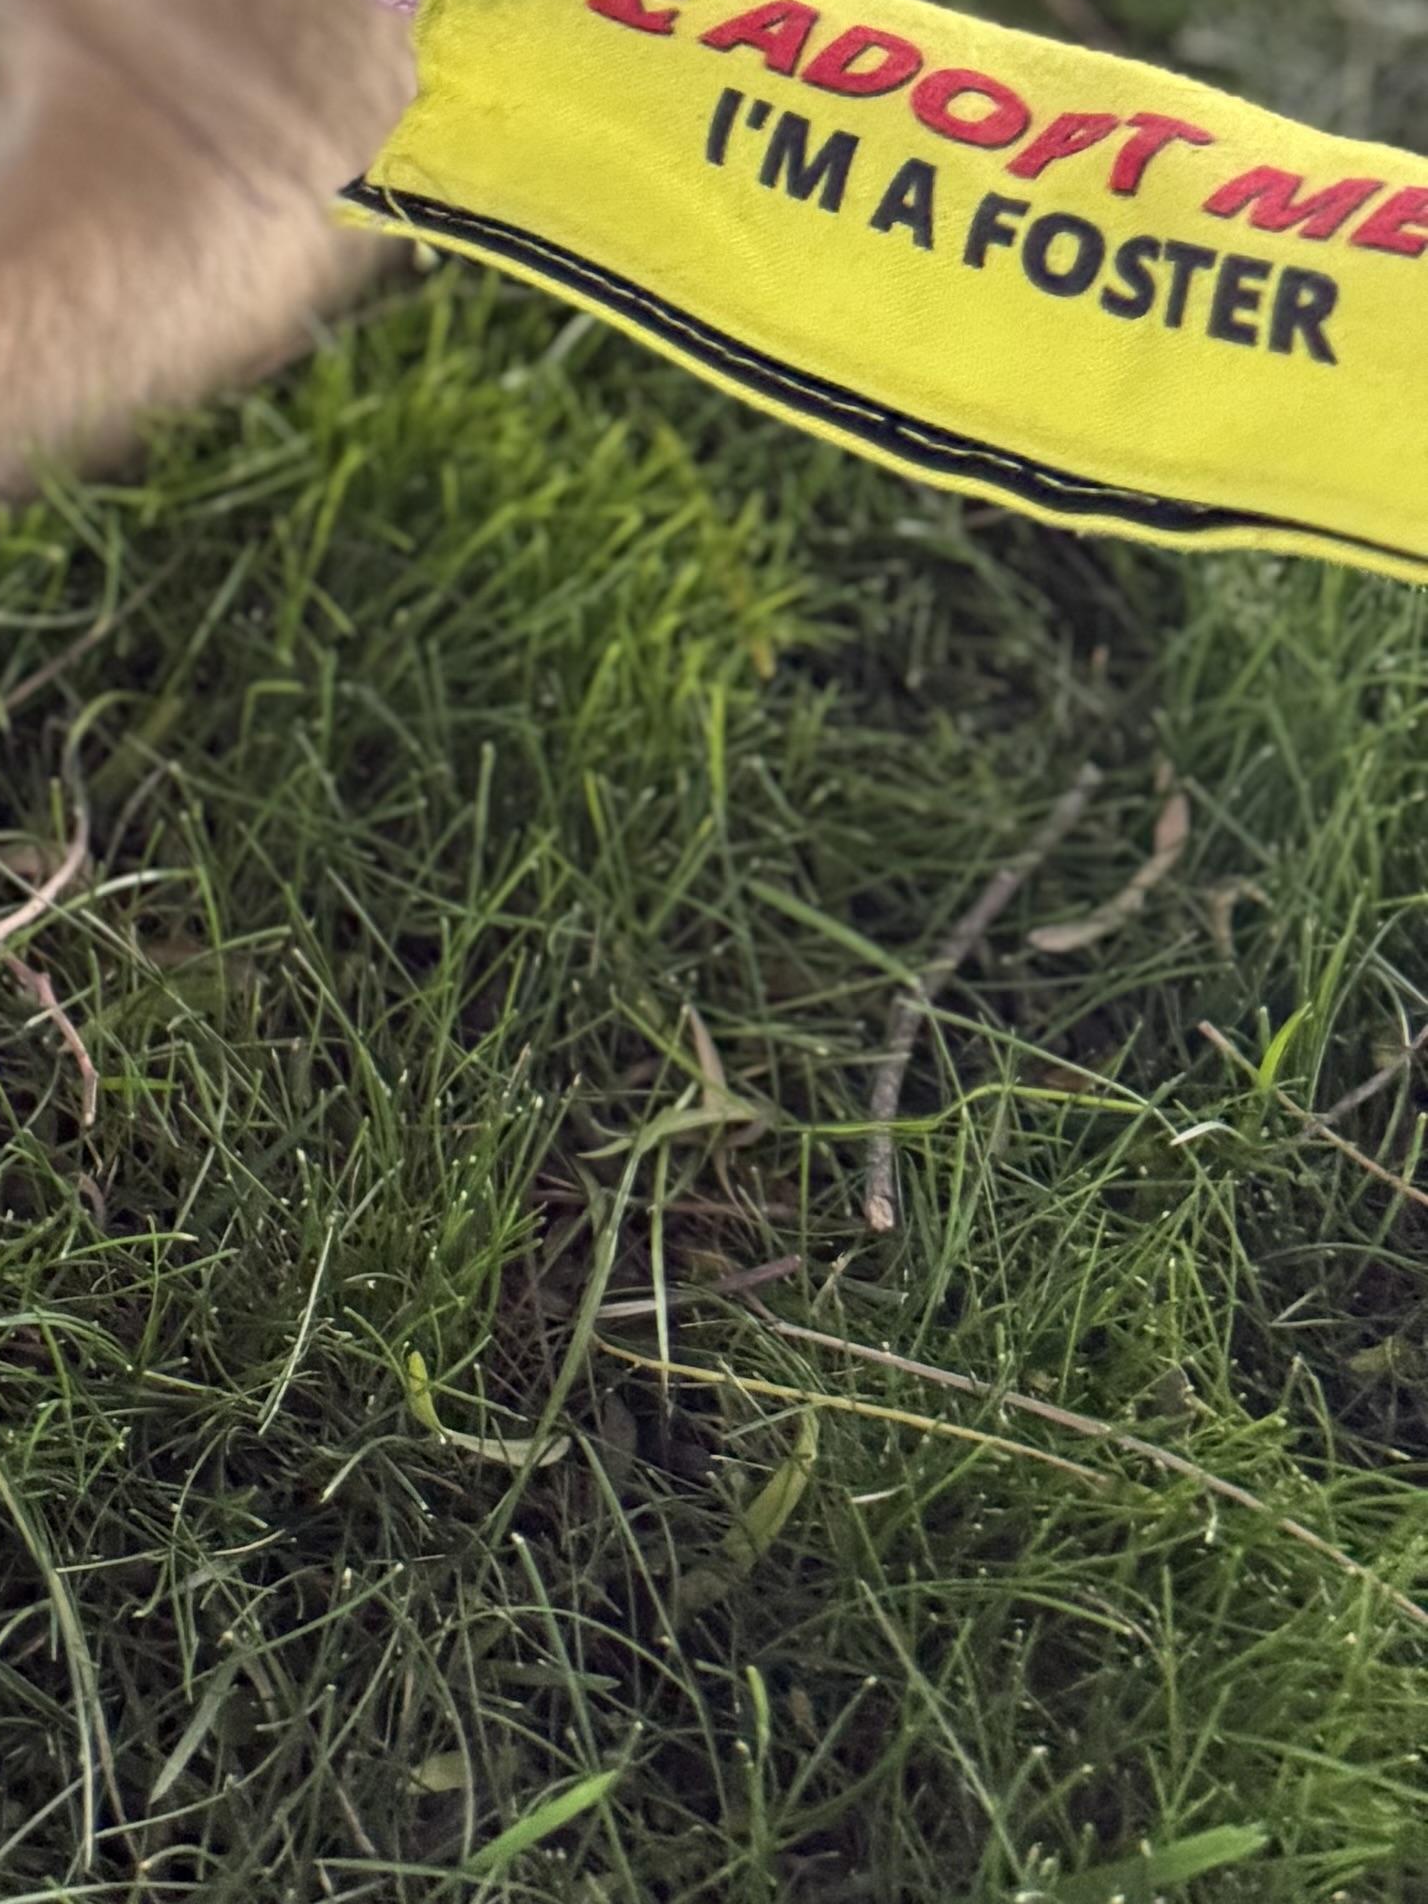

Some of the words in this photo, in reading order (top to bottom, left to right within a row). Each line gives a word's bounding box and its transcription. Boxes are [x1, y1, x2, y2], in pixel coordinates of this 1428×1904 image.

[704, 86, 861, 214] I'M
[868, 156, 938, 252] A
[961, 191, 1339, 366] FOSTER
